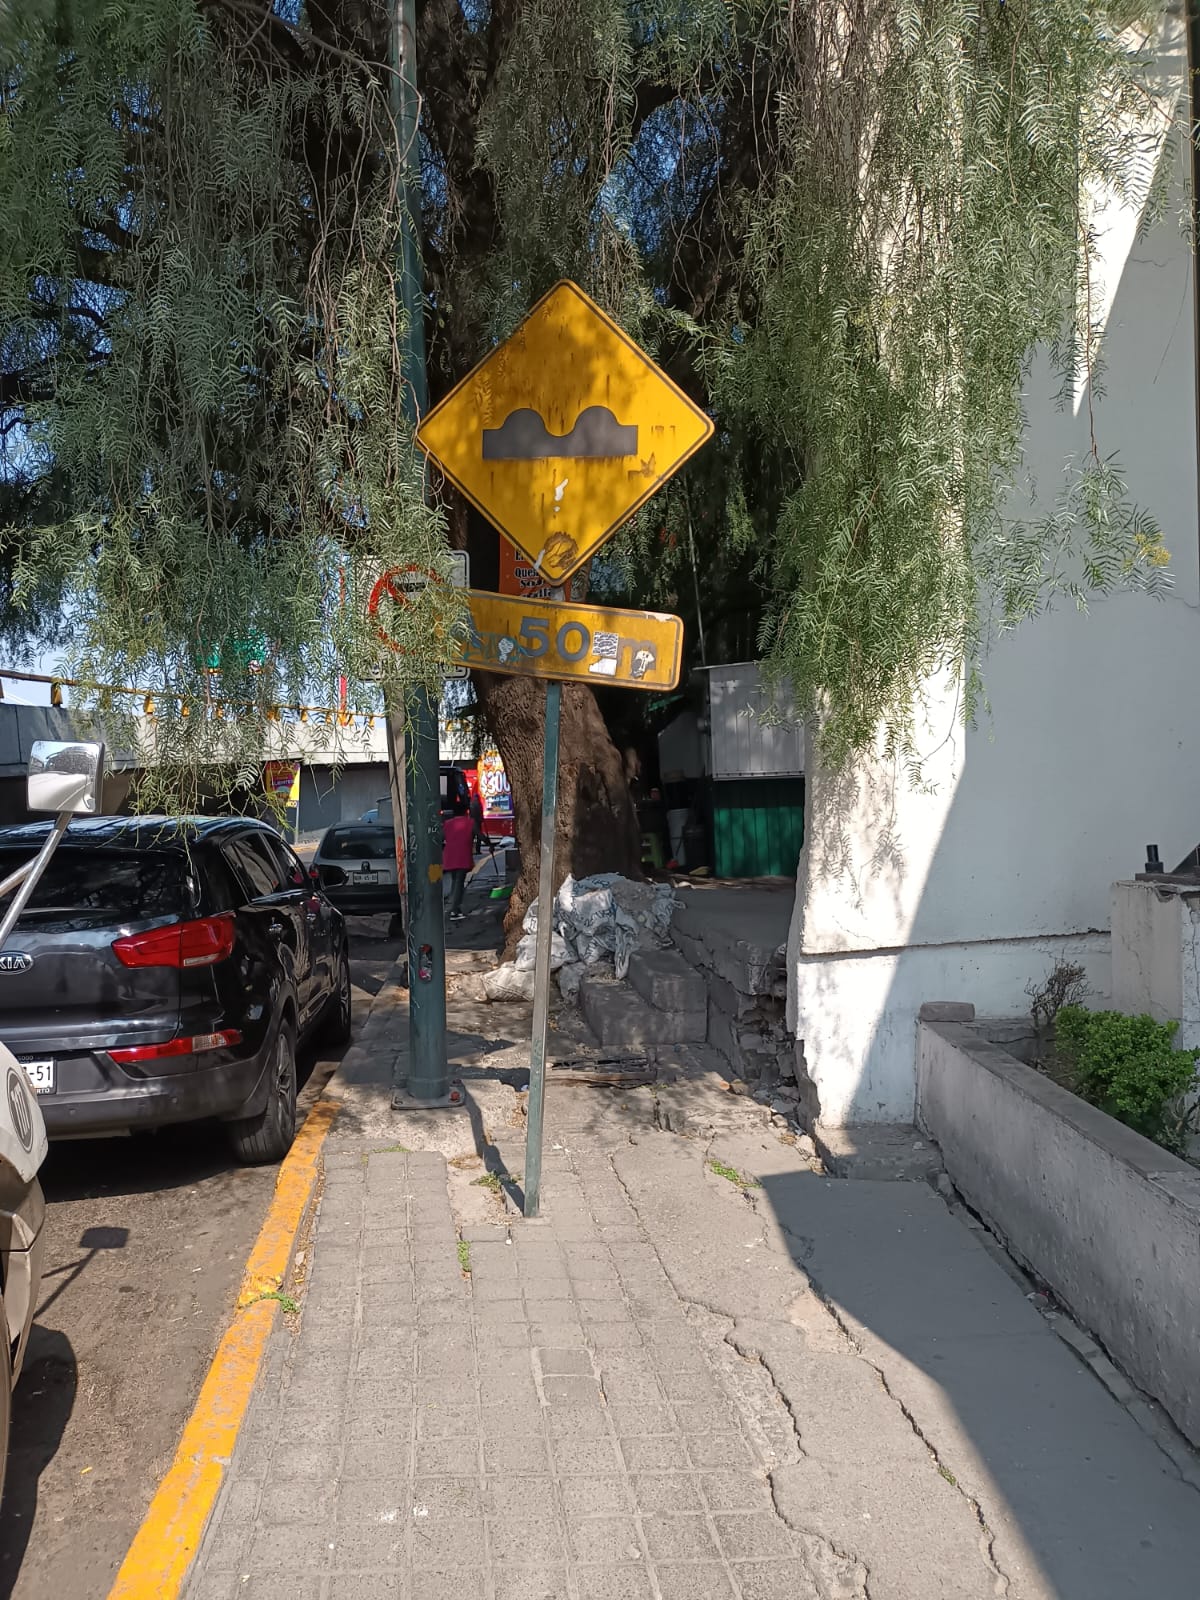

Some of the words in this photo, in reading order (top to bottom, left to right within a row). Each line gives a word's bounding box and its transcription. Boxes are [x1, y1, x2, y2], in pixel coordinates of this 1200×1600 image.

[519, 615, 591, 662] 50
[0, 957, 26, 969] KIA
[22, 1065, 51, 1081] -51
